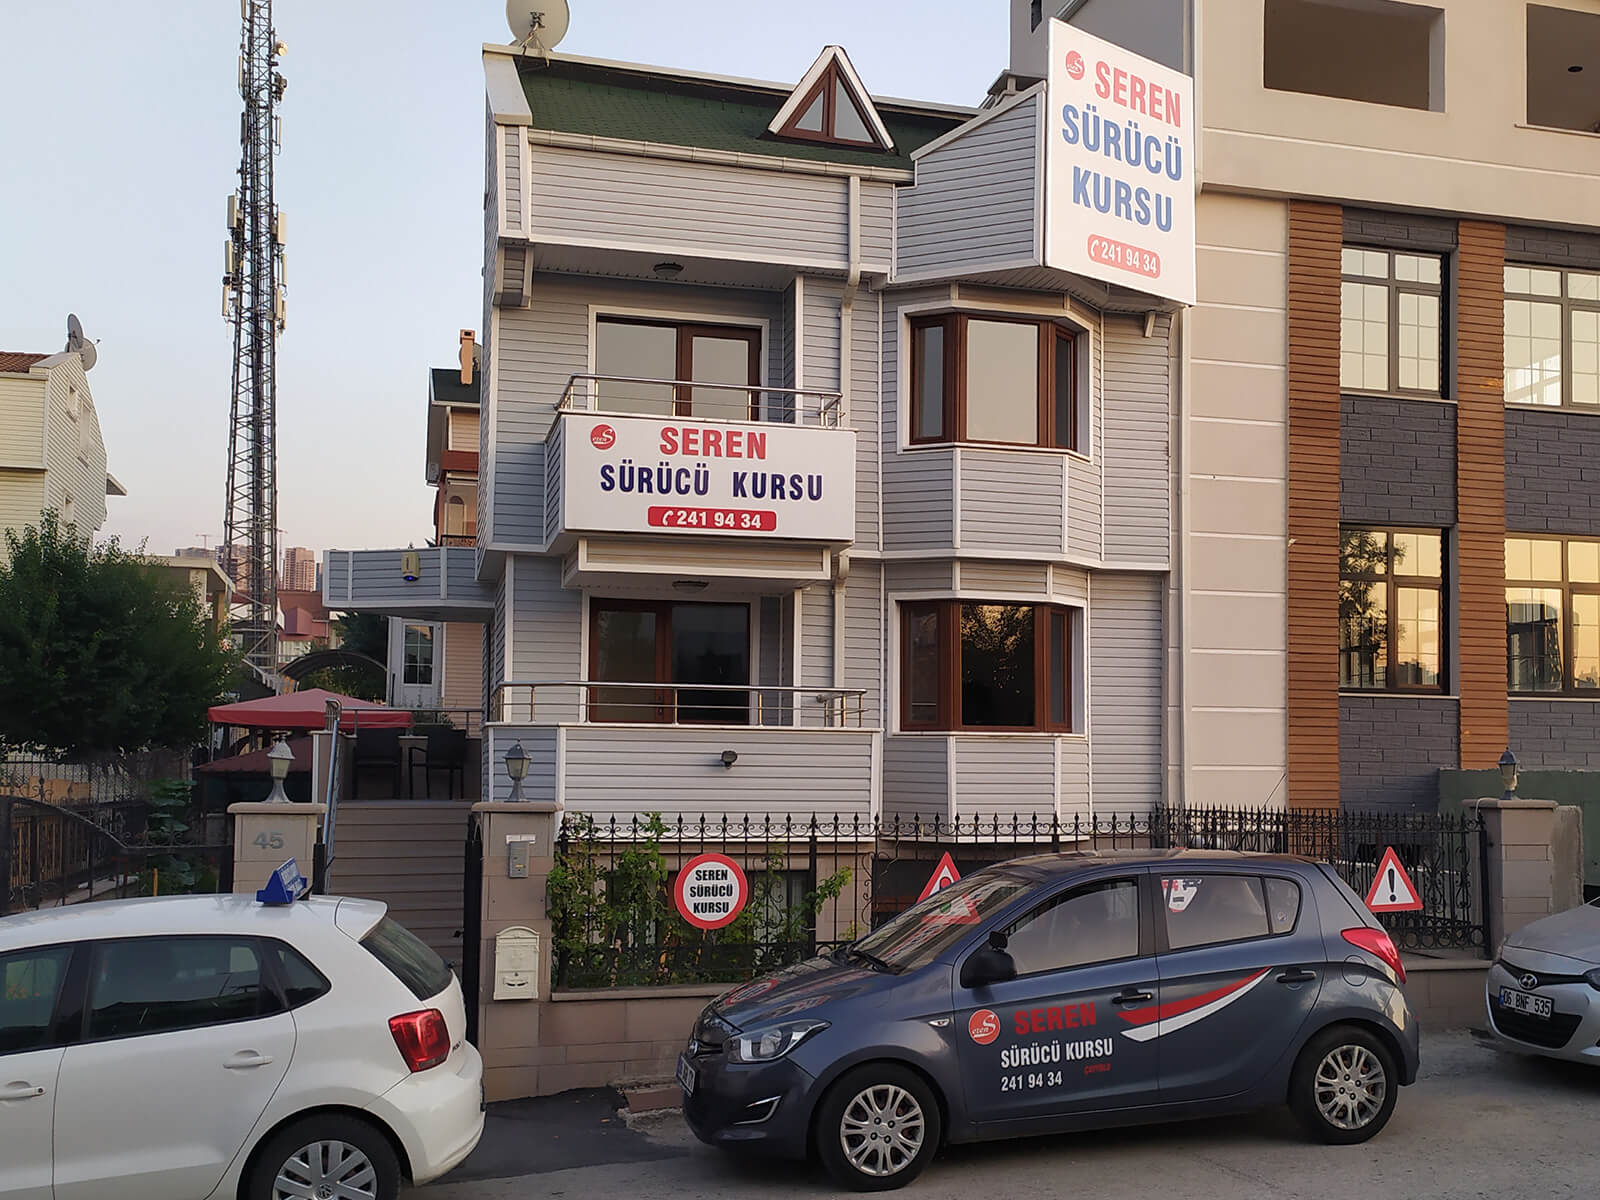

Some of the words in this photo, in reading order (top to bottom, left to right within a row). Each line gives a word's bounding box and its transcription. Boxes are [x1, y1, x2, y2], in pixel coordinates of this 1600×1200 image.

[1094, 60, 1181, 128] SEREN
[1061, 103, 1182, 181] SÜRÜCÜ
[1072, 165, 1173, 232] KURSU
[1101, 240, 1122, 264] 241
[1126, 247, 1140, 269] 94
[1142, 253, 1157, 274] 34
[659, 426, 767, 460] SEREN
[600, 459, 710, 496] SÜRÜCÜ
[732, 471, 823, 501] KURSU
[676, 510, 707, 526] 241
[713, 511, 736, 528] 94
[740, 513, 761, 529] 34
[252, 832, 284, 849] 45
[695, 869, 728, 881] SEREN
[689, 884, 733, 897] SÜRÜCÜ
[693, 901, 729, 914] KURSU
[1014, 1002, 1096, 1035] SEREN
[1534, 999, 1551, 1015] 535
[1001, 1040, 1060, 1068] SÜRÜCÜ
[1066, 1038, 1113, 1060] KURSU
[1001, 1075, 1024, 1091] 241
[1028, 1073, 1043, 1089] 94
[1047, 1071, 1062, 1086] 34
